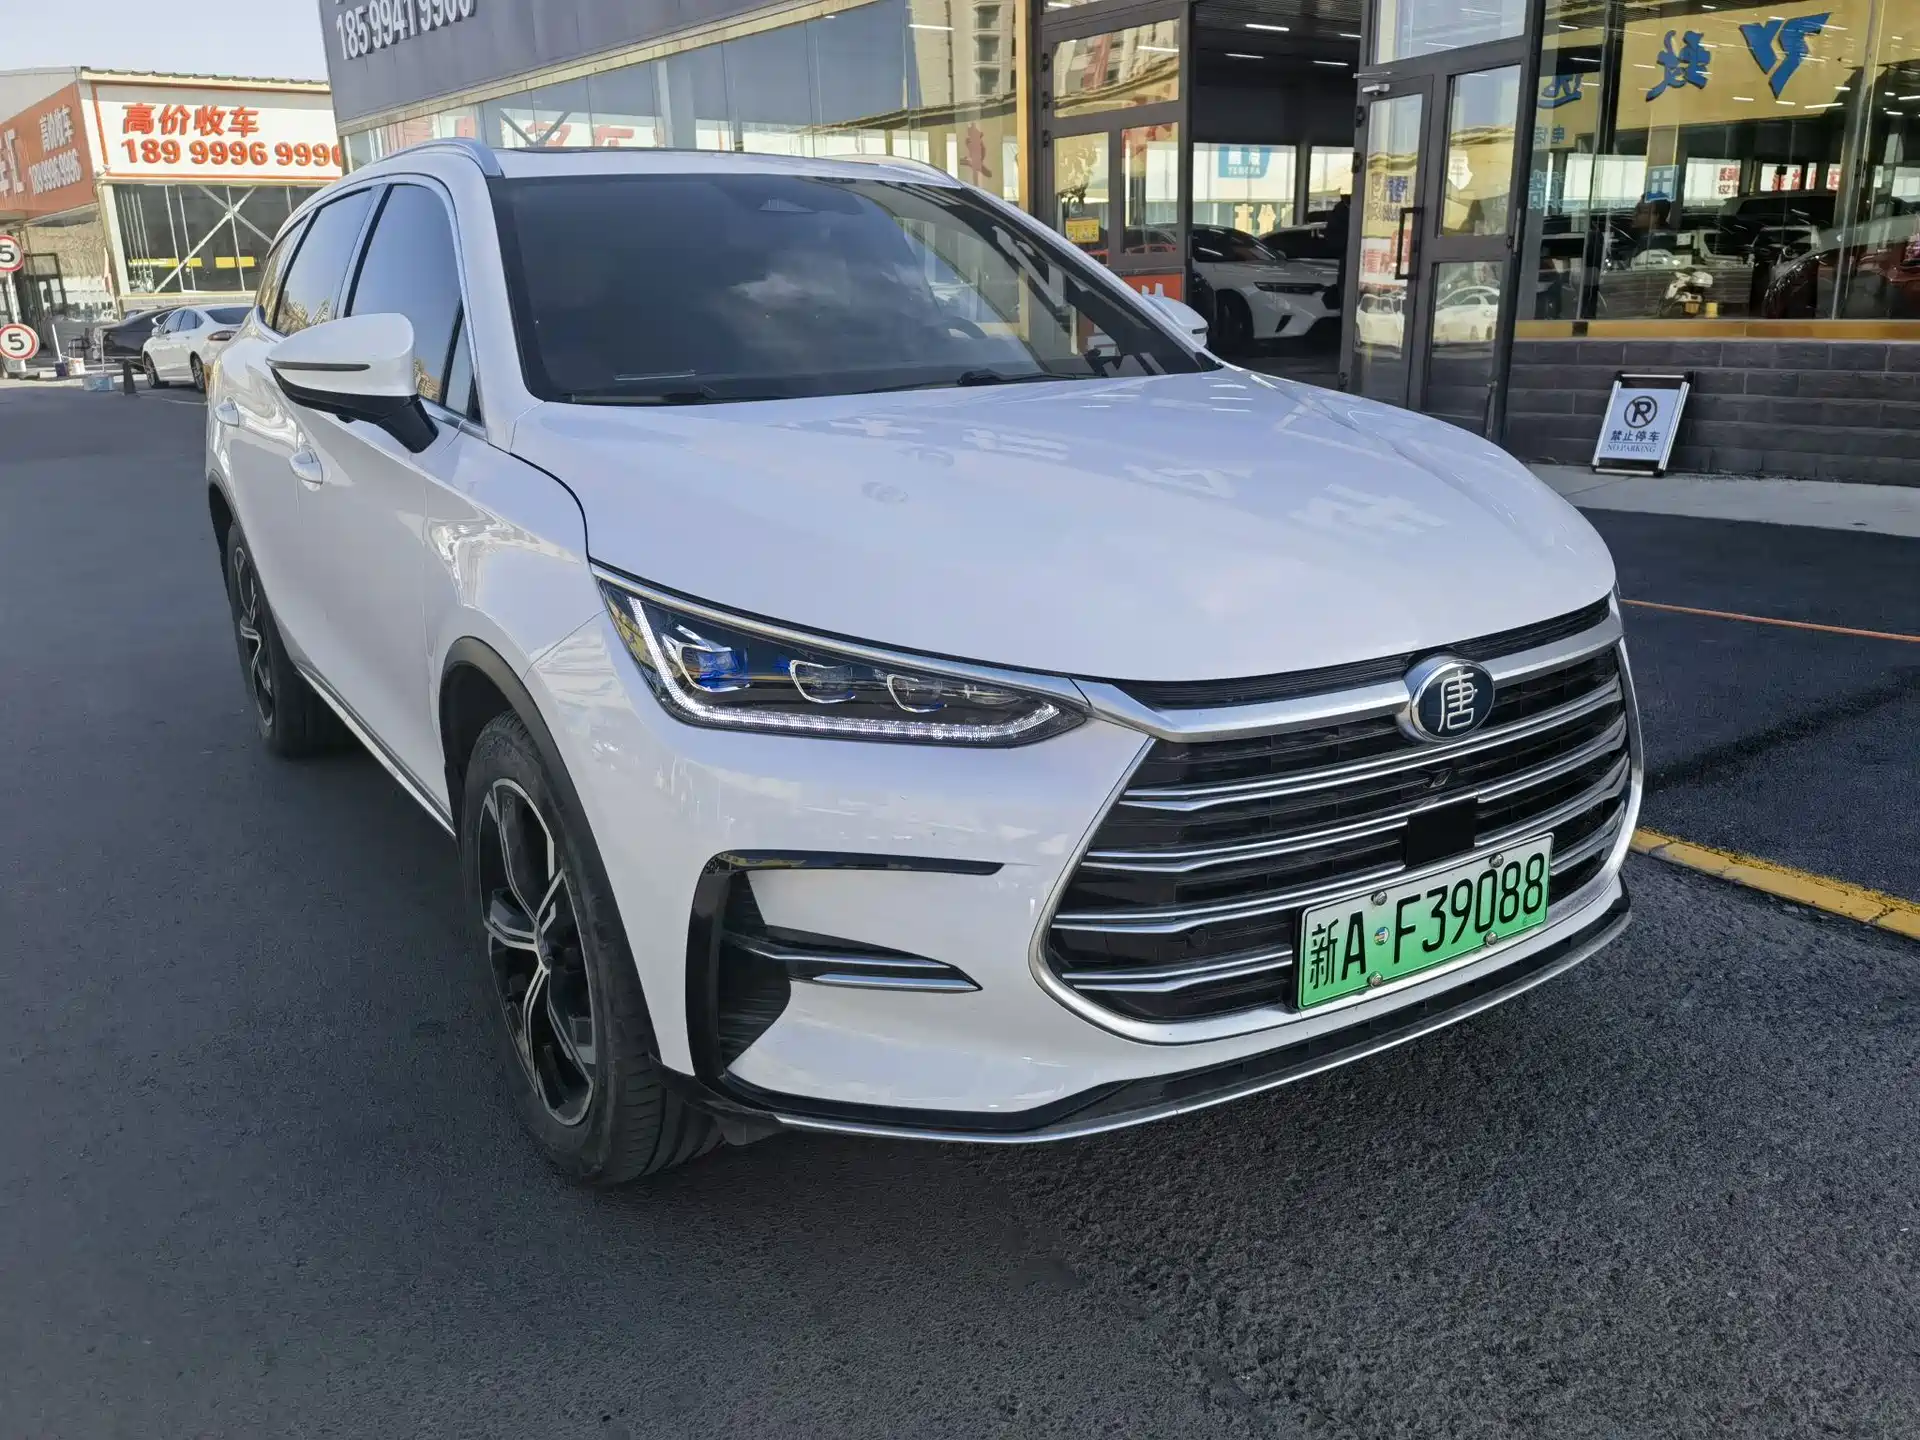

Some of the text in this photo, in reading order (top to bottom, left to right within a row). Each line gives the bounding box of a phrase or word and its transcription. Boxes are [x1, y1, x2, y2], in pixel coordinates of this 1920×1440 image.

[122, 103, 260, 137] 高价收车
[121, 138, 181, 164] 189
[189, 140, 268, 166] 9996
[0, 245, 15, 263] 5
[8, 333, 25, 351] 5
[1610, 429, 1661, 443] 禁止停车
[1438, 670, 1478, 732] 唐
[1393, 852, 1546, 965] F39088
